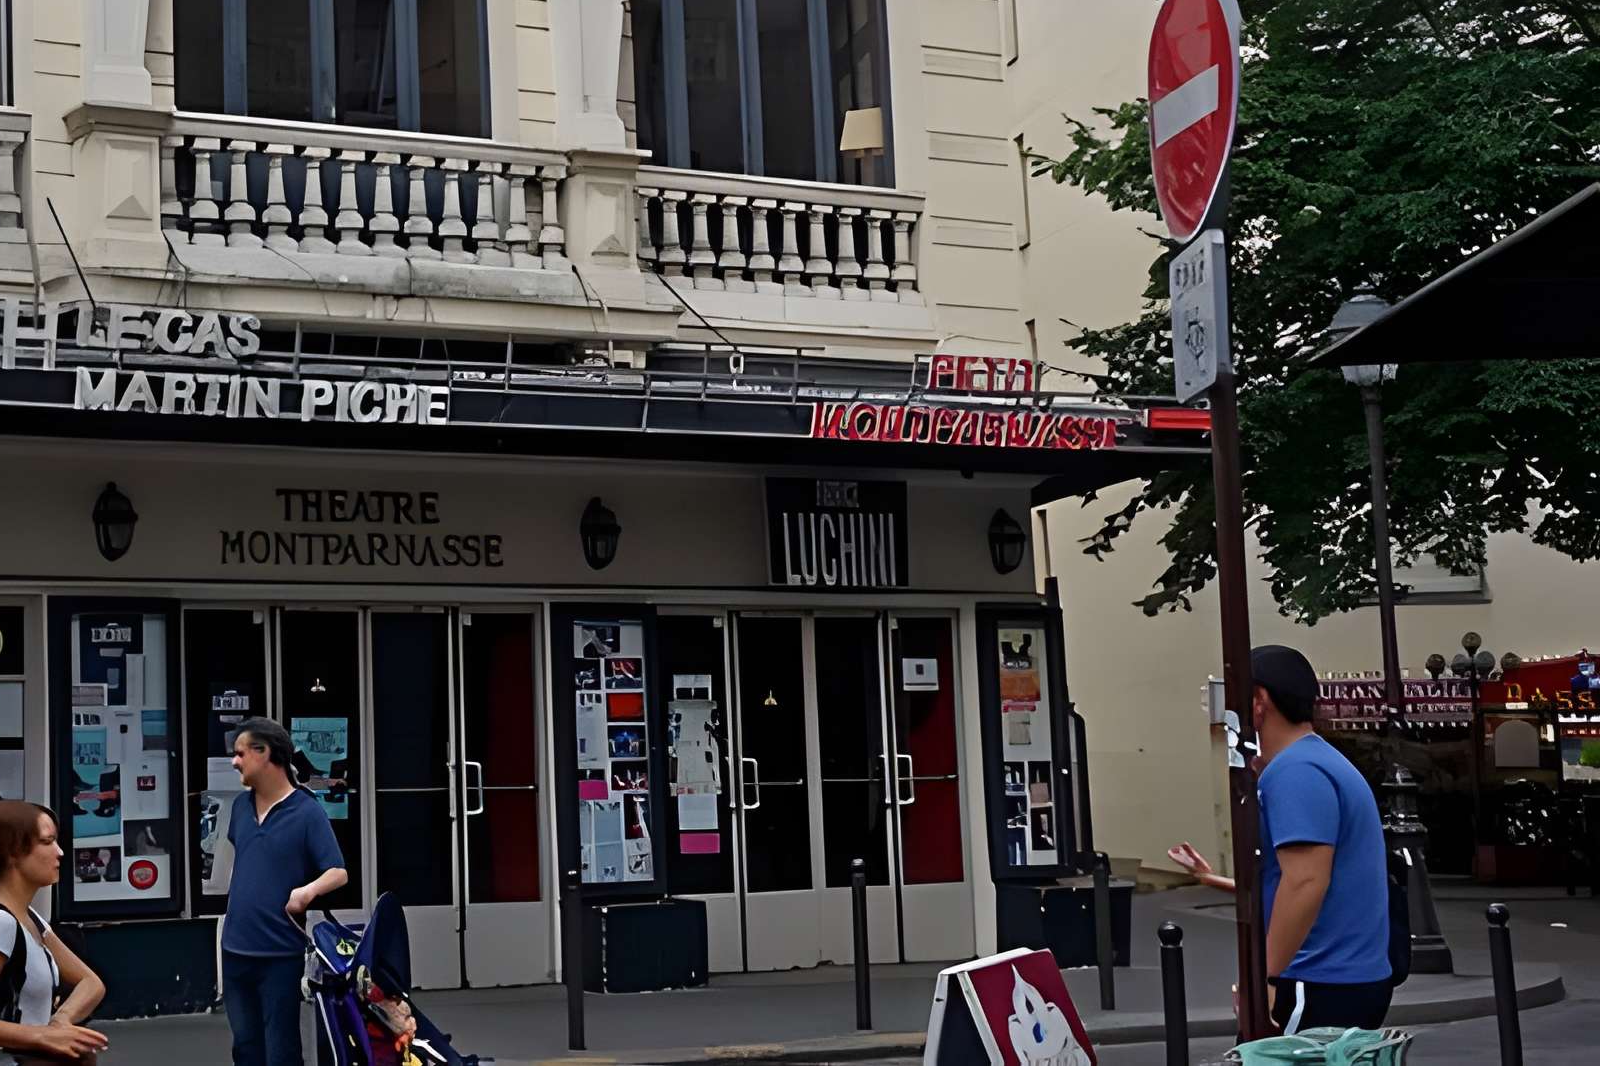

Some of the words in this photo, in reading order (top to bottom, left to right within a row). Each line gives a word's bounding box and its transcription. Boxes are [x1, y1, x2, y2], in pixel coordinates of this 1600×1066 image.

[74, 366, 281, 419] MARTIN
[300, 379, 451, 426] PICHE
[275, 488, 441, 524] THEATRE
[220, 530, 504, 567] MONTPARNASSE
[783, 512, 898, 587] LUCHINI
